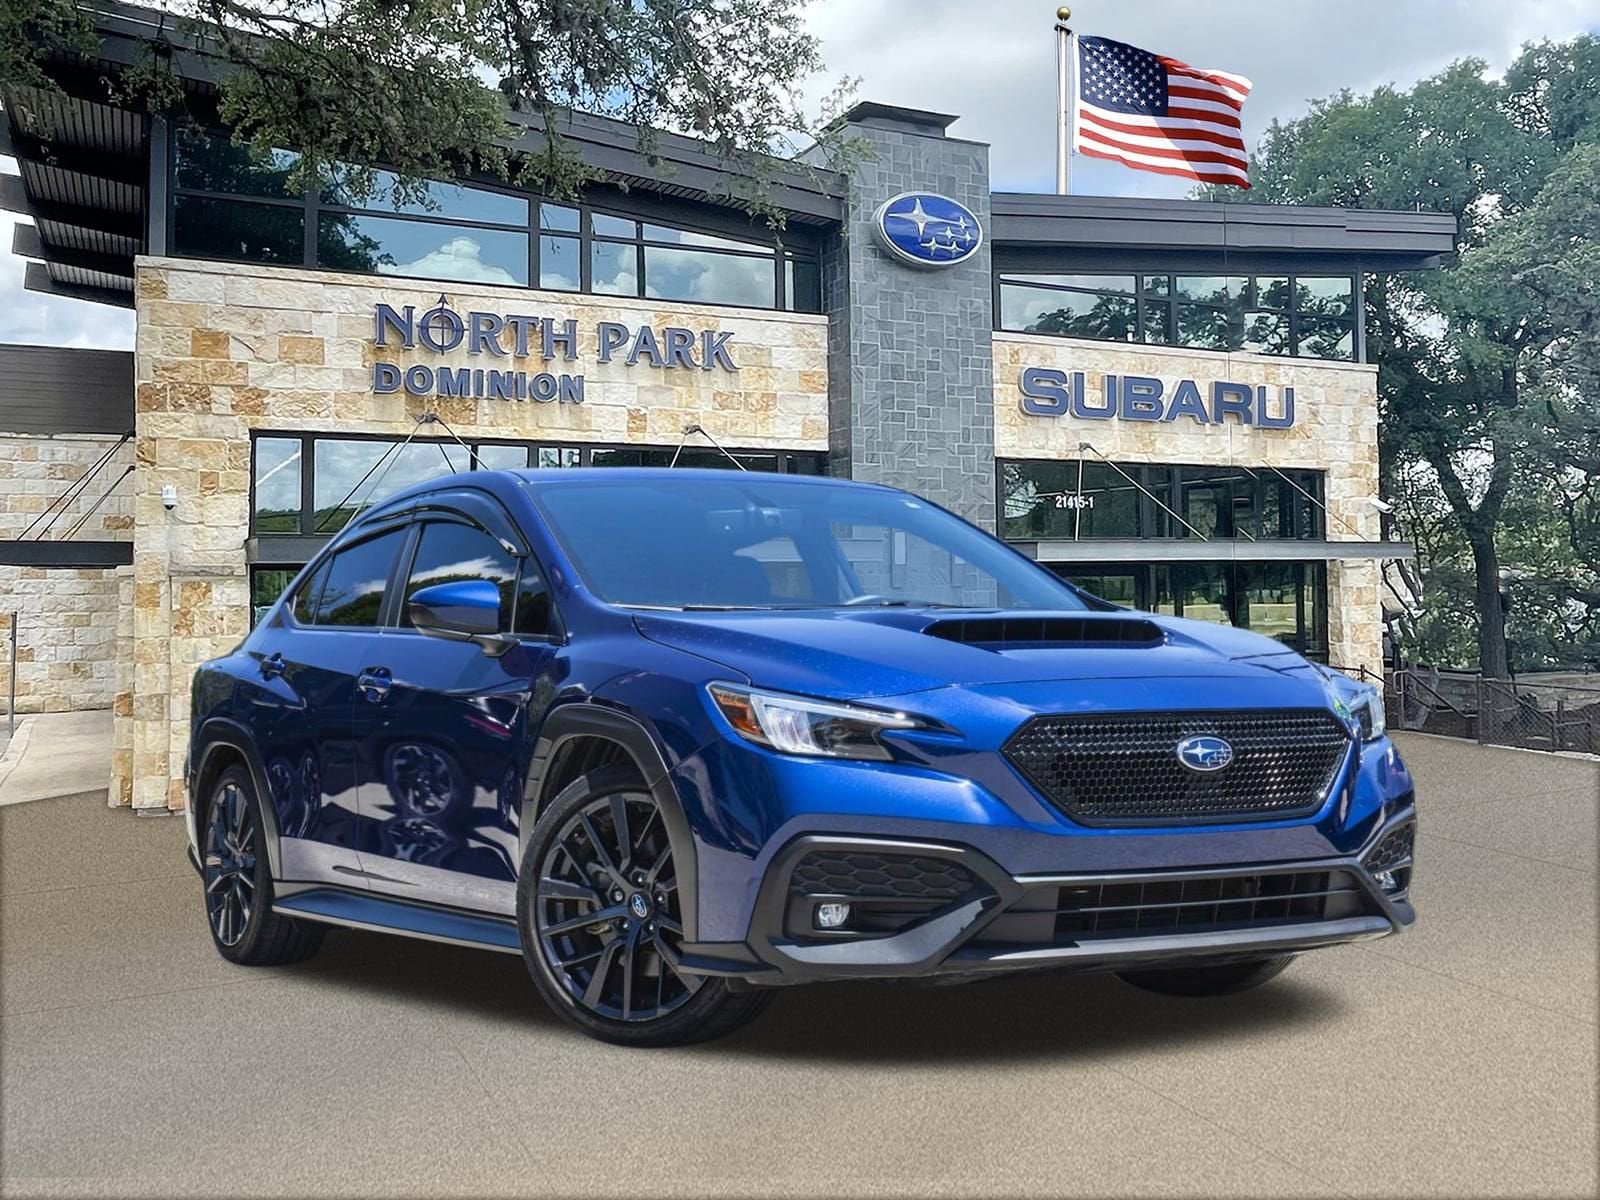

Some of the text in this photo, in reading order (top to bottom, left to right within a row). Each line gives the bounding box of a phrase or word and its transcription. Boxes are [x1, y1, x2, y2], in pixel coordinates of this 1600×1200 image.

[375, 299, 741, 373] NORTH PARK
[373, 362, 584, 403] DOMINION
[1020, 367, 1295, 430] SUBARU
[1055, 495, 1094, 509] 21415-1
